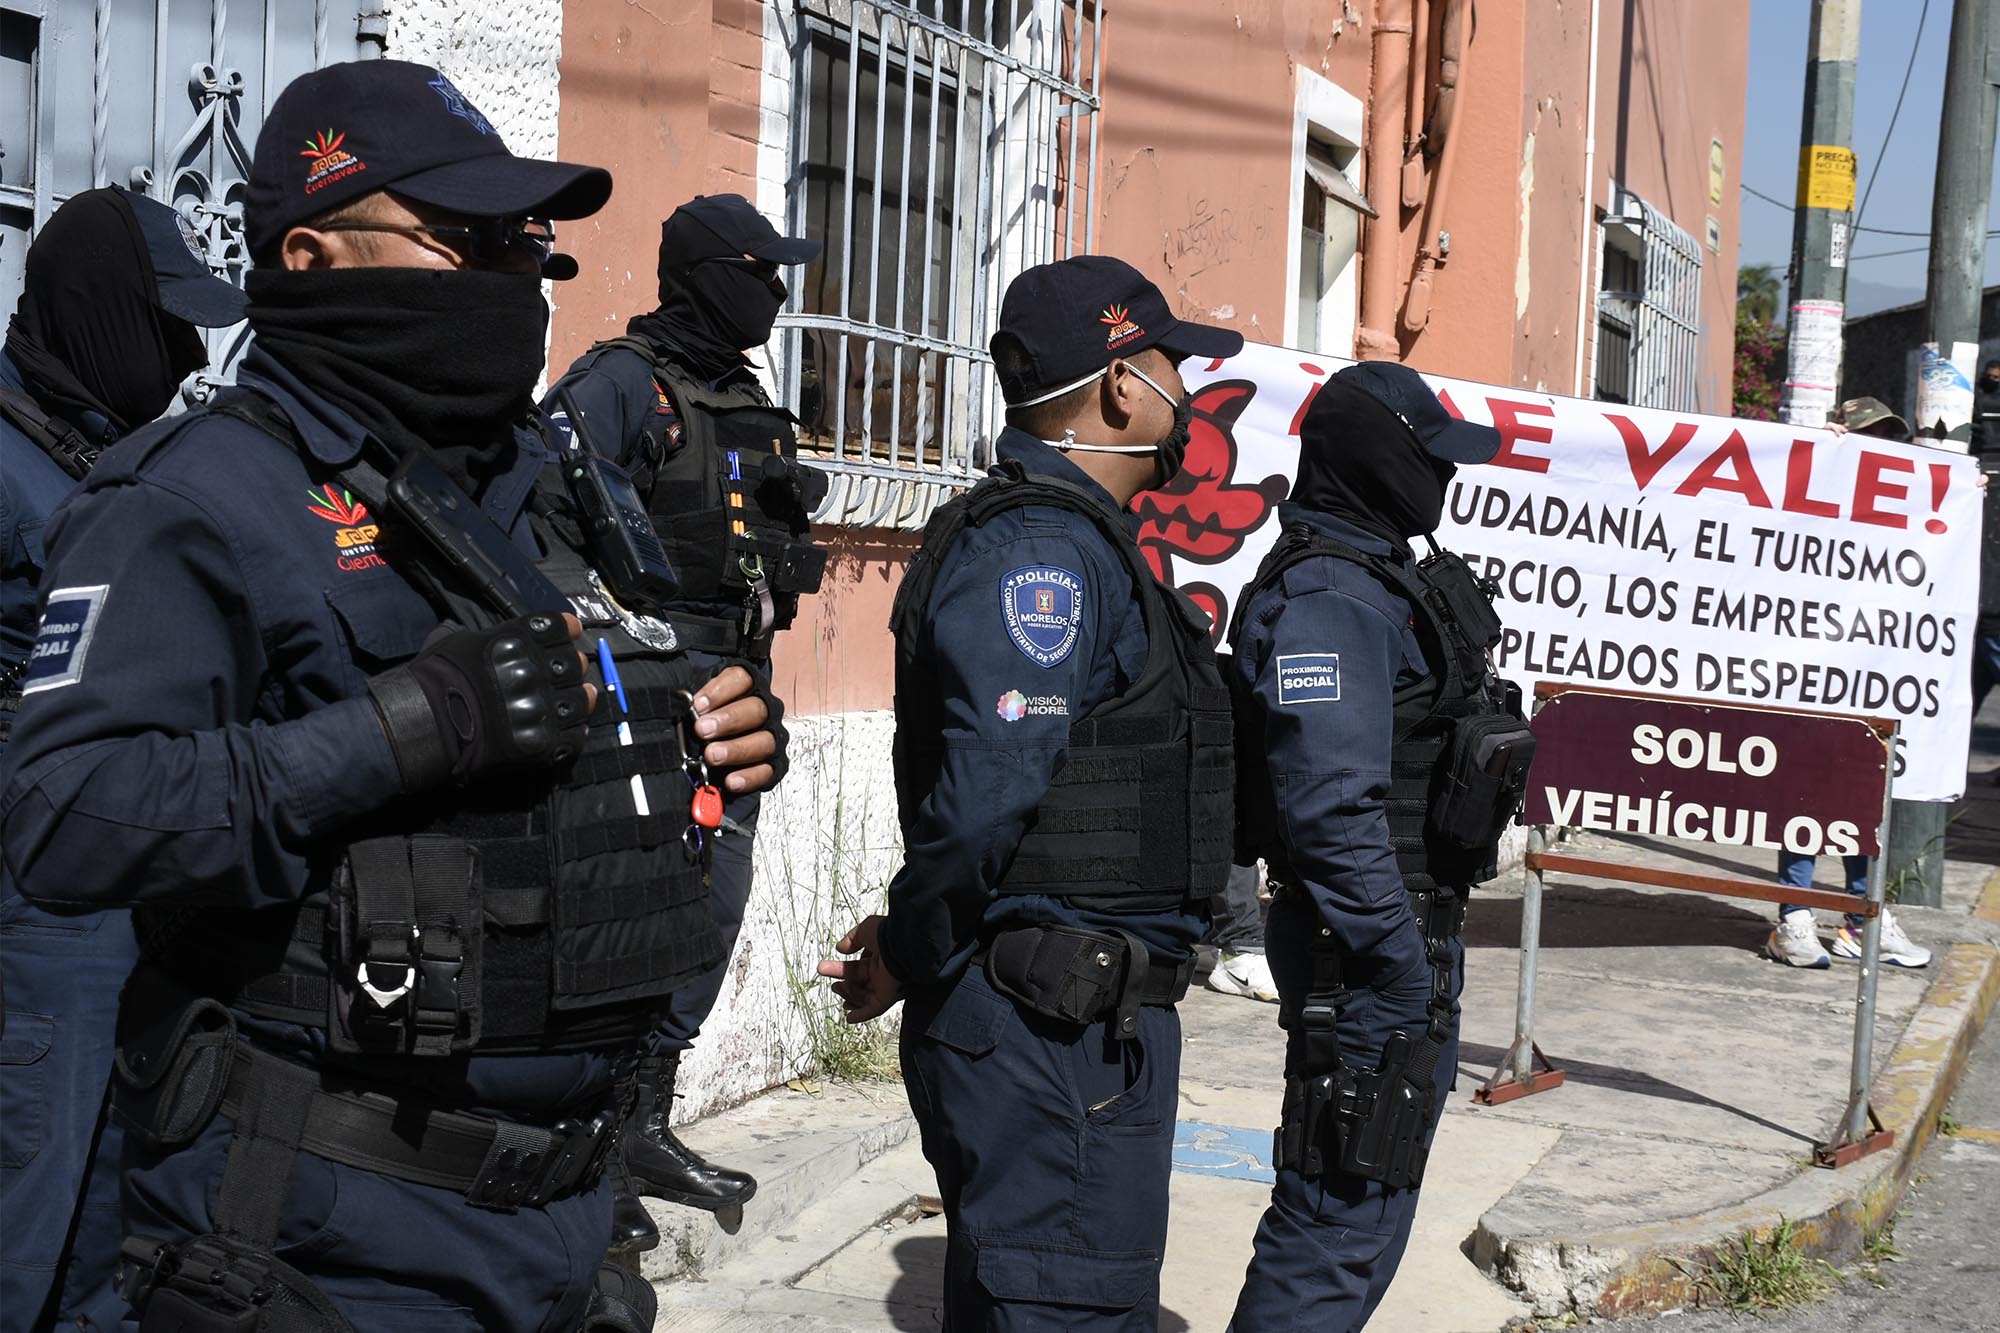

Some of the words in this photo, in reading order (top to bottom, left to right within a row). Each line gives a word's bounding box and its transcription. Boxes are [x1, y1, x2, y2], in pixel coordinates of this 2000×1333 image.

[305, 162, 367, 194] Cuernavaca
[1106, 329, 1145, 350] Cuernavaca
[1601, 413, 1951, 535] VALE!
[1450, 482, 1678, 563] UDADANÍA,
[1694, 518, 1736, 564] EL
[1751, 527, 1934, 597] TURISMO,
[1015, 571, 1072, 588] POLICÍA
[1004, 587, 1016, 627] COMISIÓN
[1012, 627, 1035, 655] ESTATAL
[1036, 652, 1048, 662] DE
[1049, 626, 1077, 661] SEGURIDAD
[1072, 591, 1082, 626] PÚBLICA
[1020, 613, 1068, 626] MORELOS
[1604, 573, 1679, 622] LOS
[1691, 586, 1956, 657] EMPRESARIOS
[31, 640, 70, 660] CIAL
[1281, 666, 1334, 675] PROXIMIDAD
[1283, 676, 1335, 690] SOCIAL
[1499, 627, 1679, 689] PLEADOS
[1696, 653, 1940, 718] DESPEDIDOS
[1027, 694, 1067, 706] VISIÓN
[1027, 706, 1069, 715] MOREL
[1631, 724, 1778, 778] SOLO
[1544, 786, 1860, 857] VEHÍCULOS
